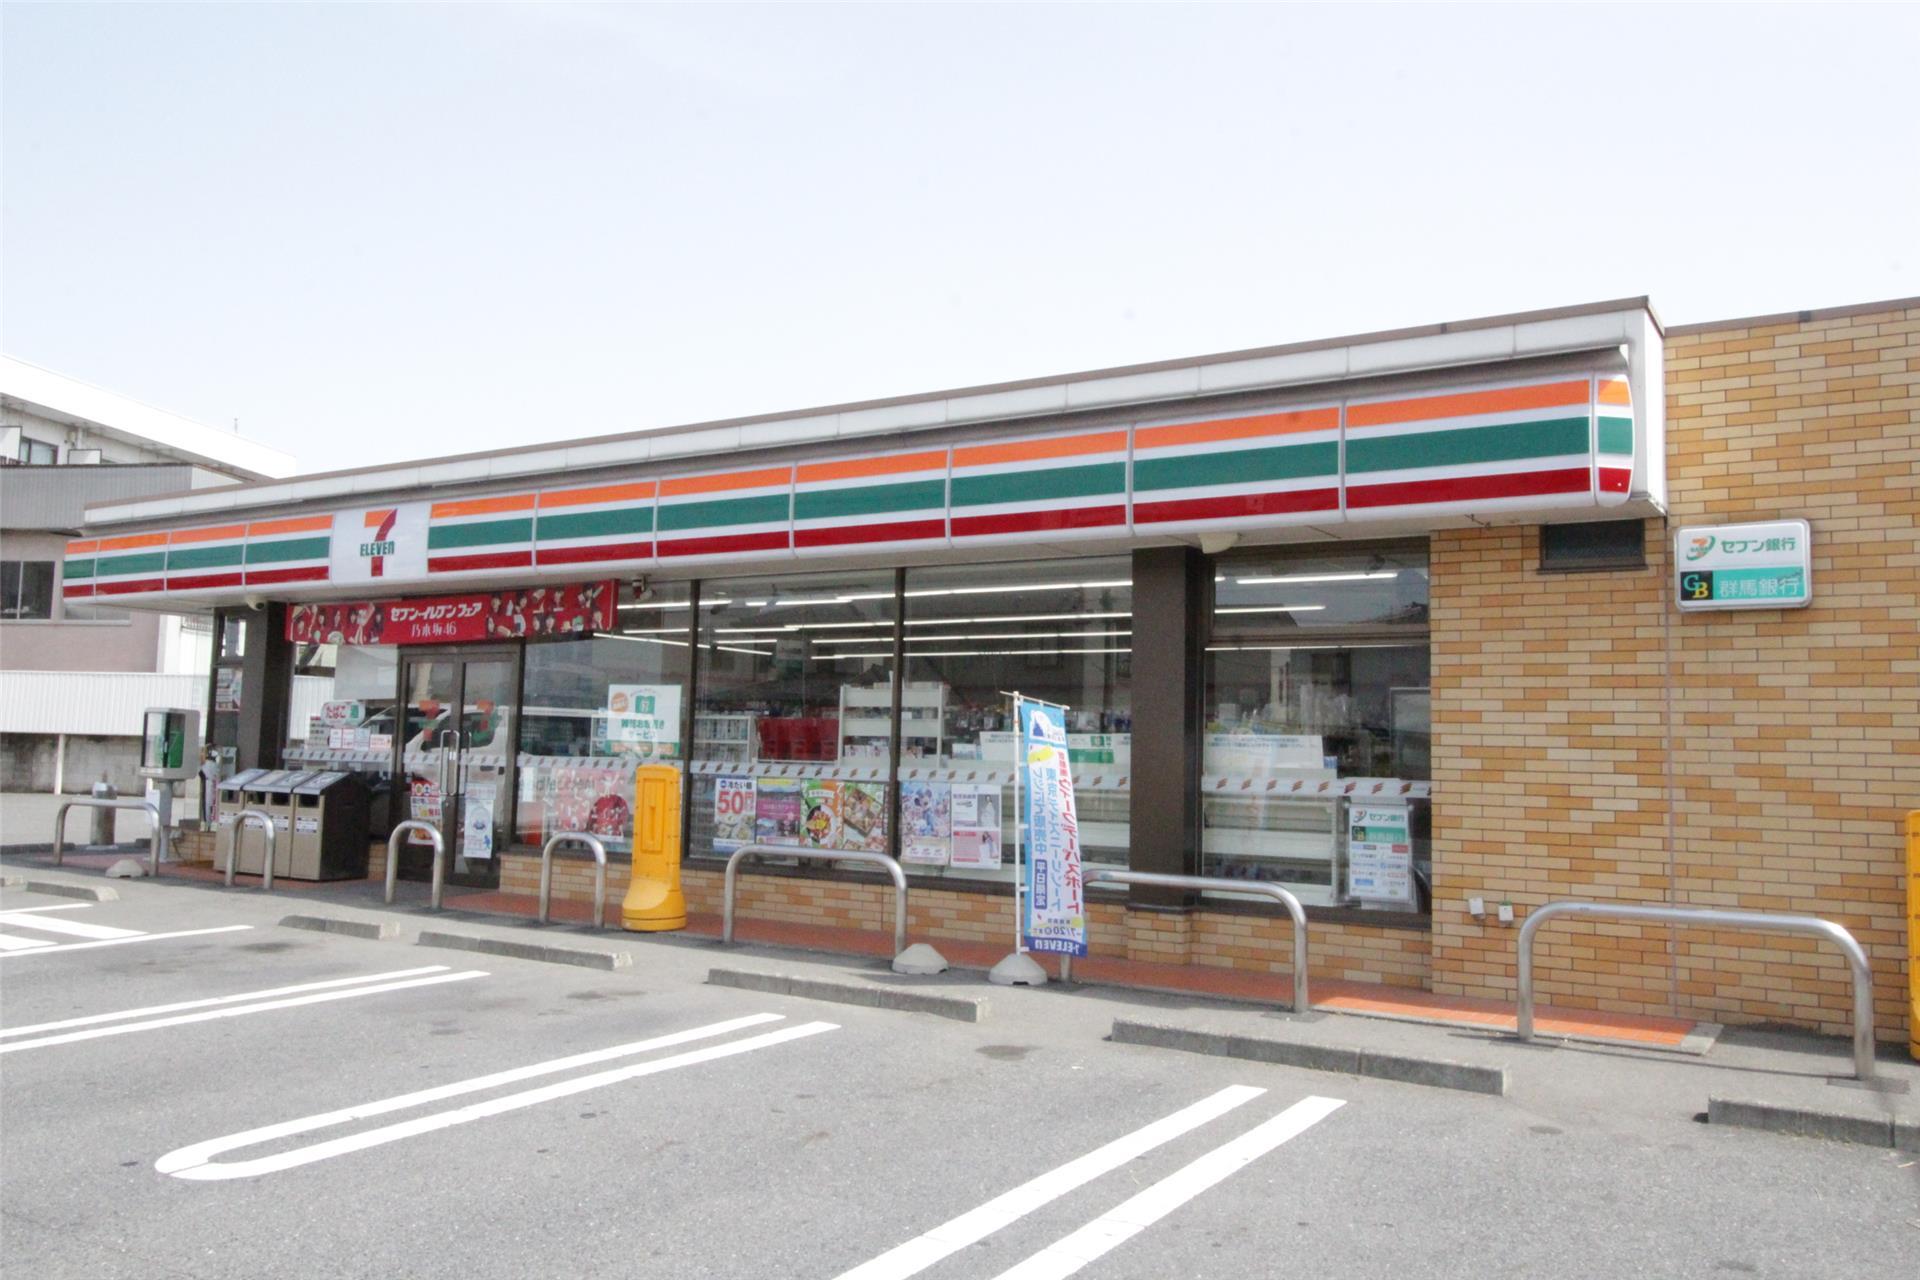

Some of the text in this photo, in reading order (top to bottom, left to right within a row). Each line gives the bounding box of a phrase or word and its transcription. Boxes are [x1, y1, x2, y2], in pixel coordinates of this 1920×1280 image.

[1721, 536, 1797, 554] セブン銀行
[1720, 578, 1800, 597] 群馬銀行
[458, 602, 482, 618] フェア
